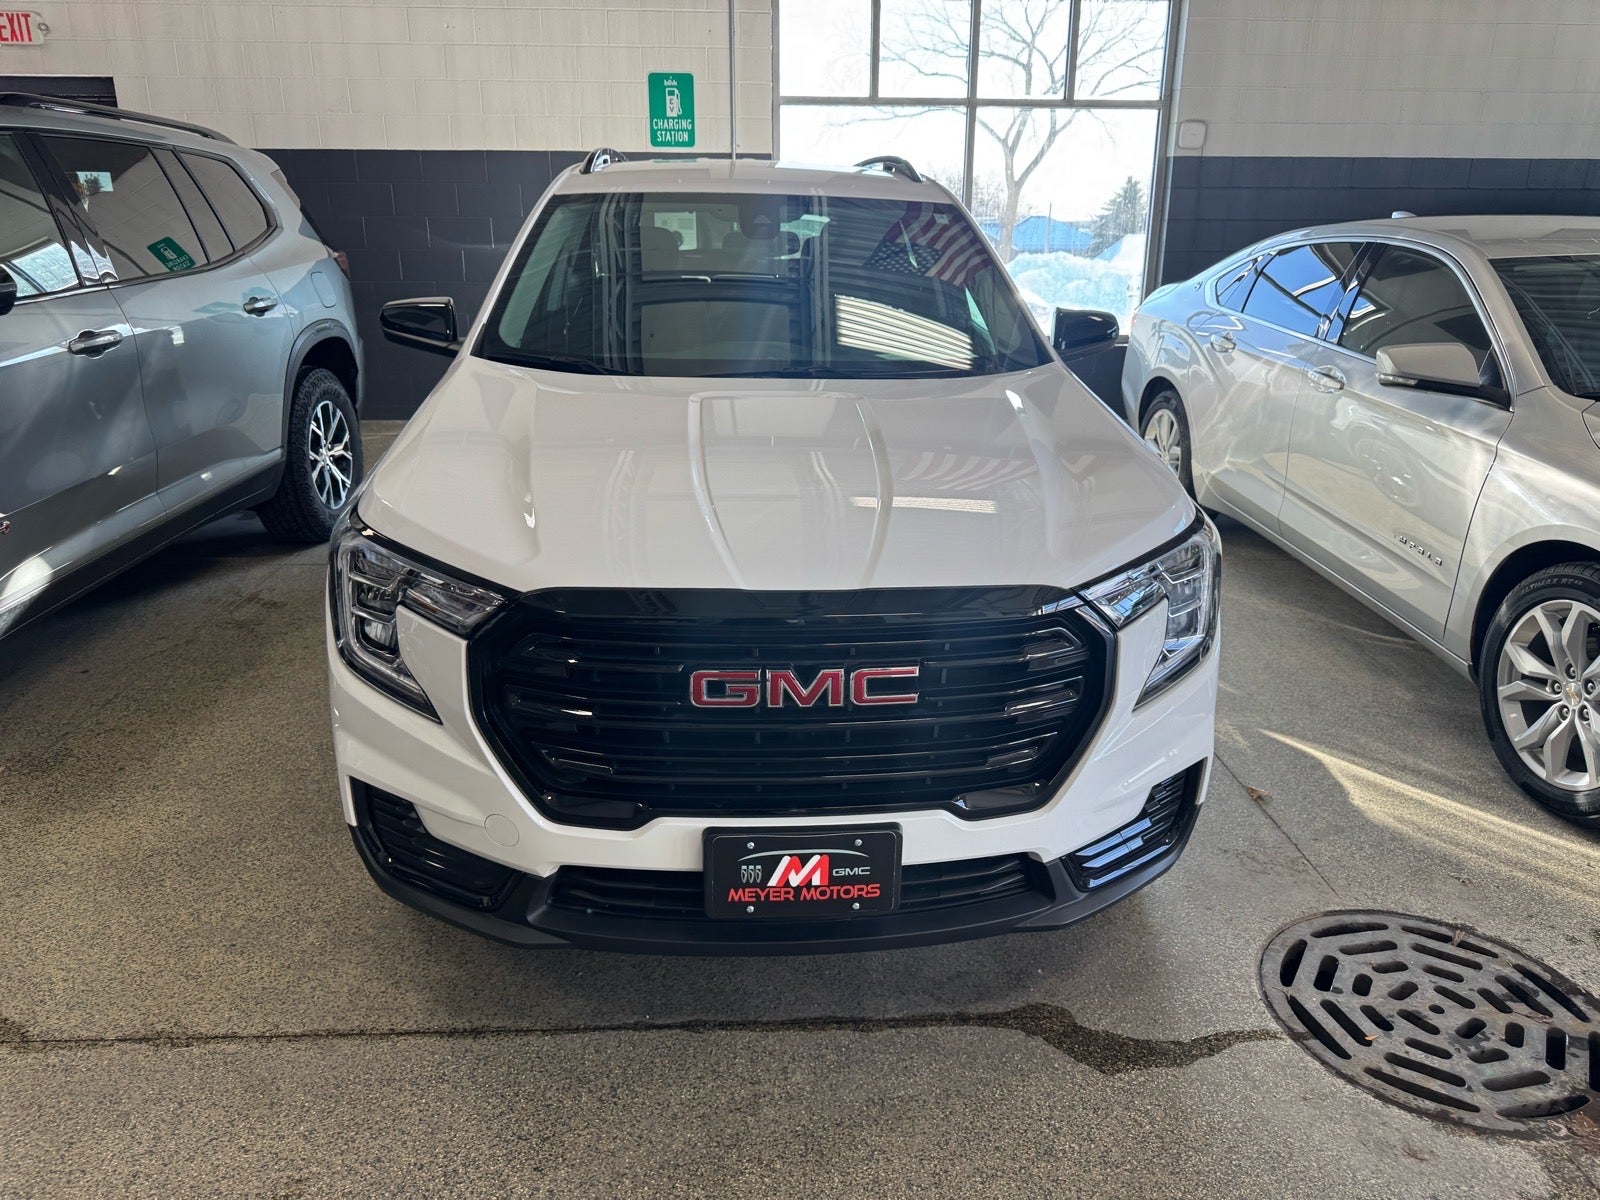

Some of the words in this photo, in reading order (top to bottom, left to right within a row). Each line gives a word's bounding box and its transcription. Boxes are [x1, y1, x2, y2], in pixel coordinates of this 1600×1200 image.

[0, 12, 33, 42] EXIT
[652, 118, 692, 130] CHARGING
[656, 130, 689, 142] STATION
[690, 665, 921, 708] GMC
[832, 866, 871, 877] GMC
[728, 887, 795, 902] MEYER
[800, 883, 881, 901] MOTORS
